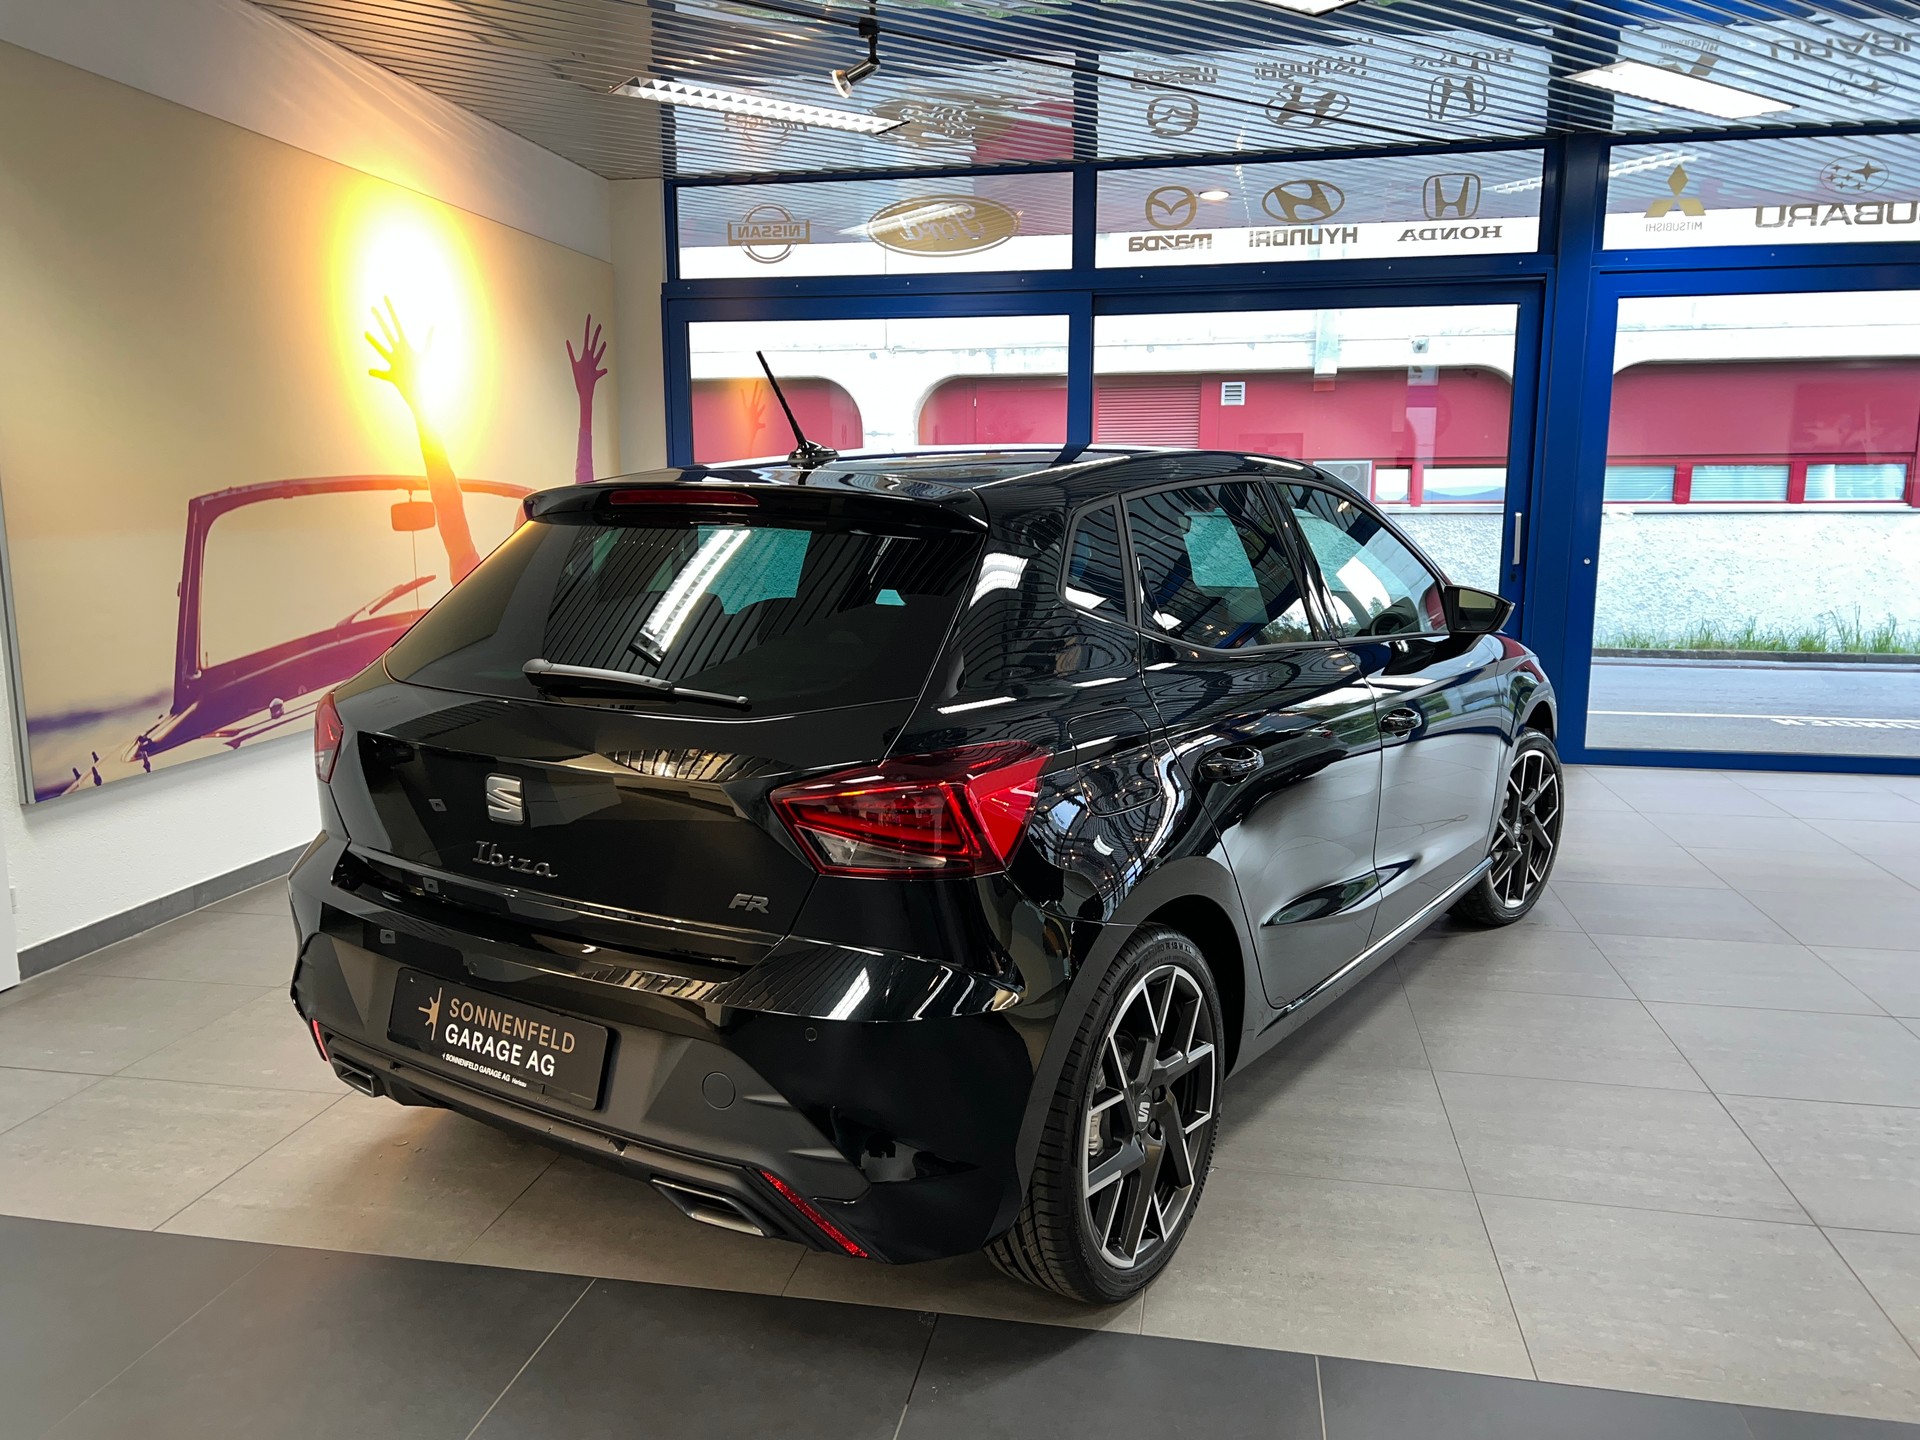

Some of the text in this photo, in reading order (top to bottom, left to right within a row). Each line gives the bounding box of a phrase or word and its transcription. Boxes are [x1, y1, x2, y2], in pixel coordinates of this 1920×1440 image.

[472, 840, 558, 878] Ibiza
[728, 893, 770, 914] FR
[449, 998, 575, 1054] SONNENFELD
[445, 1023, 555, 1077] GARAGE AG
[445, 1053, 479, 1071] SONNENFELD
[479, 1065, 502, 1079] GARAGE
[501, 1073, 511, 1082] AG
